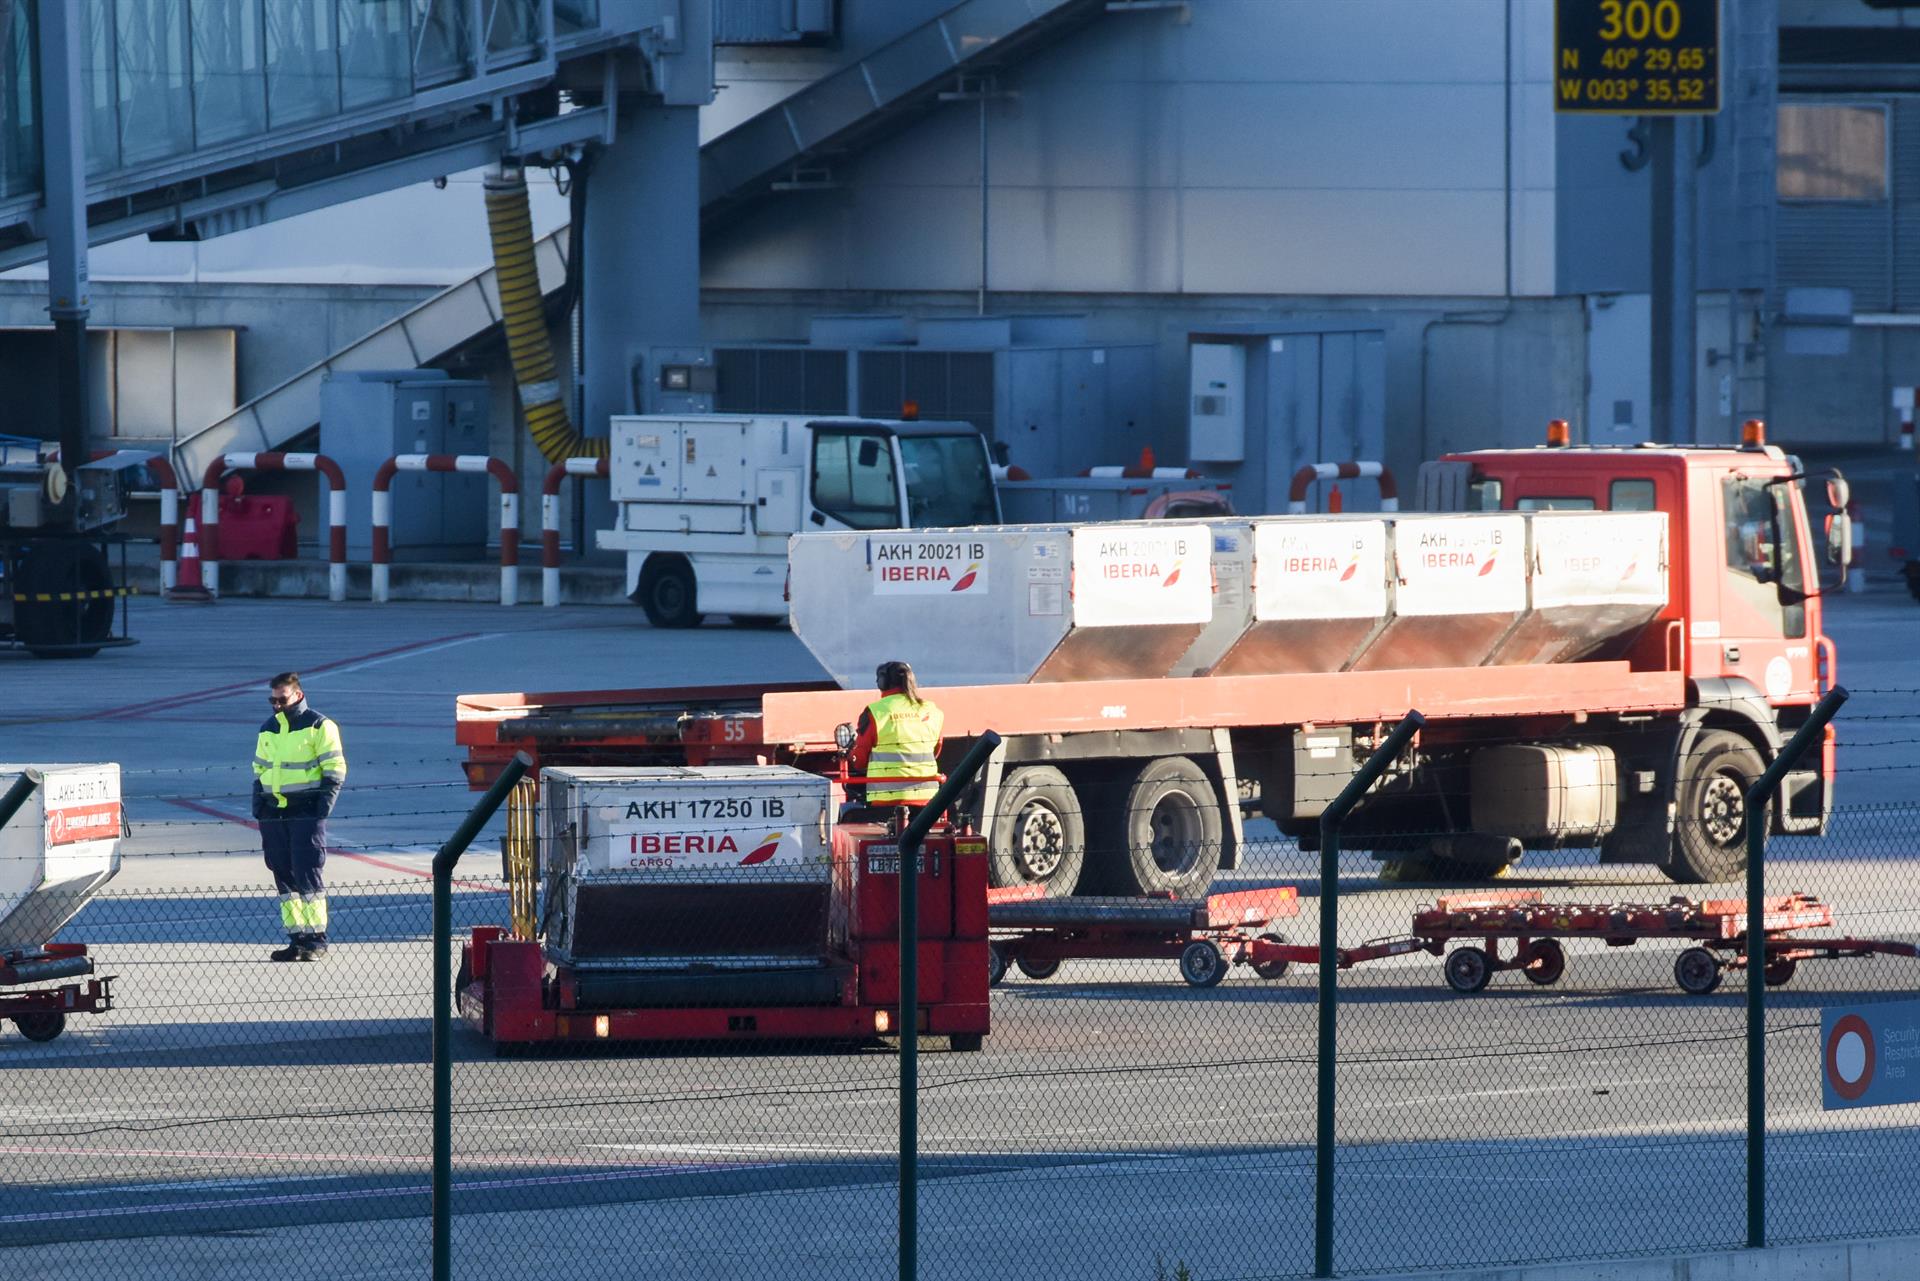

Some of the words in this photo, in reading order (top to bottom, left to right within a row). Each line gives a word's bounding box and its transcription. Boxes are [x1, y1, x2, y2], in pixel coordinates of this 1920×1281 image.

[1599, 0, 1680, 40] 300
[1562, 49, 1579, 69] N
[1560, 80, 1581, 100] W
[1420, 531, 1447, 547] AKH
[1491, 529, 1503, 545] IB
[877, 543, 913, 560] AKH
[918, 543, 962, 560] 20021
[968, 543, 985, 560] IB
[1099, 541, 1128, 557] AKH
[1174, 540, 1187, 555] IB
[1284, 557, 1338, 572] IBERIA
[1422, 552, 1476, 568] IBERIA
[882, 566, 951, 581] IBERIA
[1103, 563, 1161, 578] IBERIA
[724, 720, 745, 741] 55
[59, 783, 75, 800] AKH
[626, 801, 676, 819] AKH
[688, 800, 752, 818] 17250
[762, 800, 785, 818] IB
[630, 835, 738, 854] IBERIA
[630, 858, 673, 867] CARGO
[1884, 1064, 1906, 1080] Area
